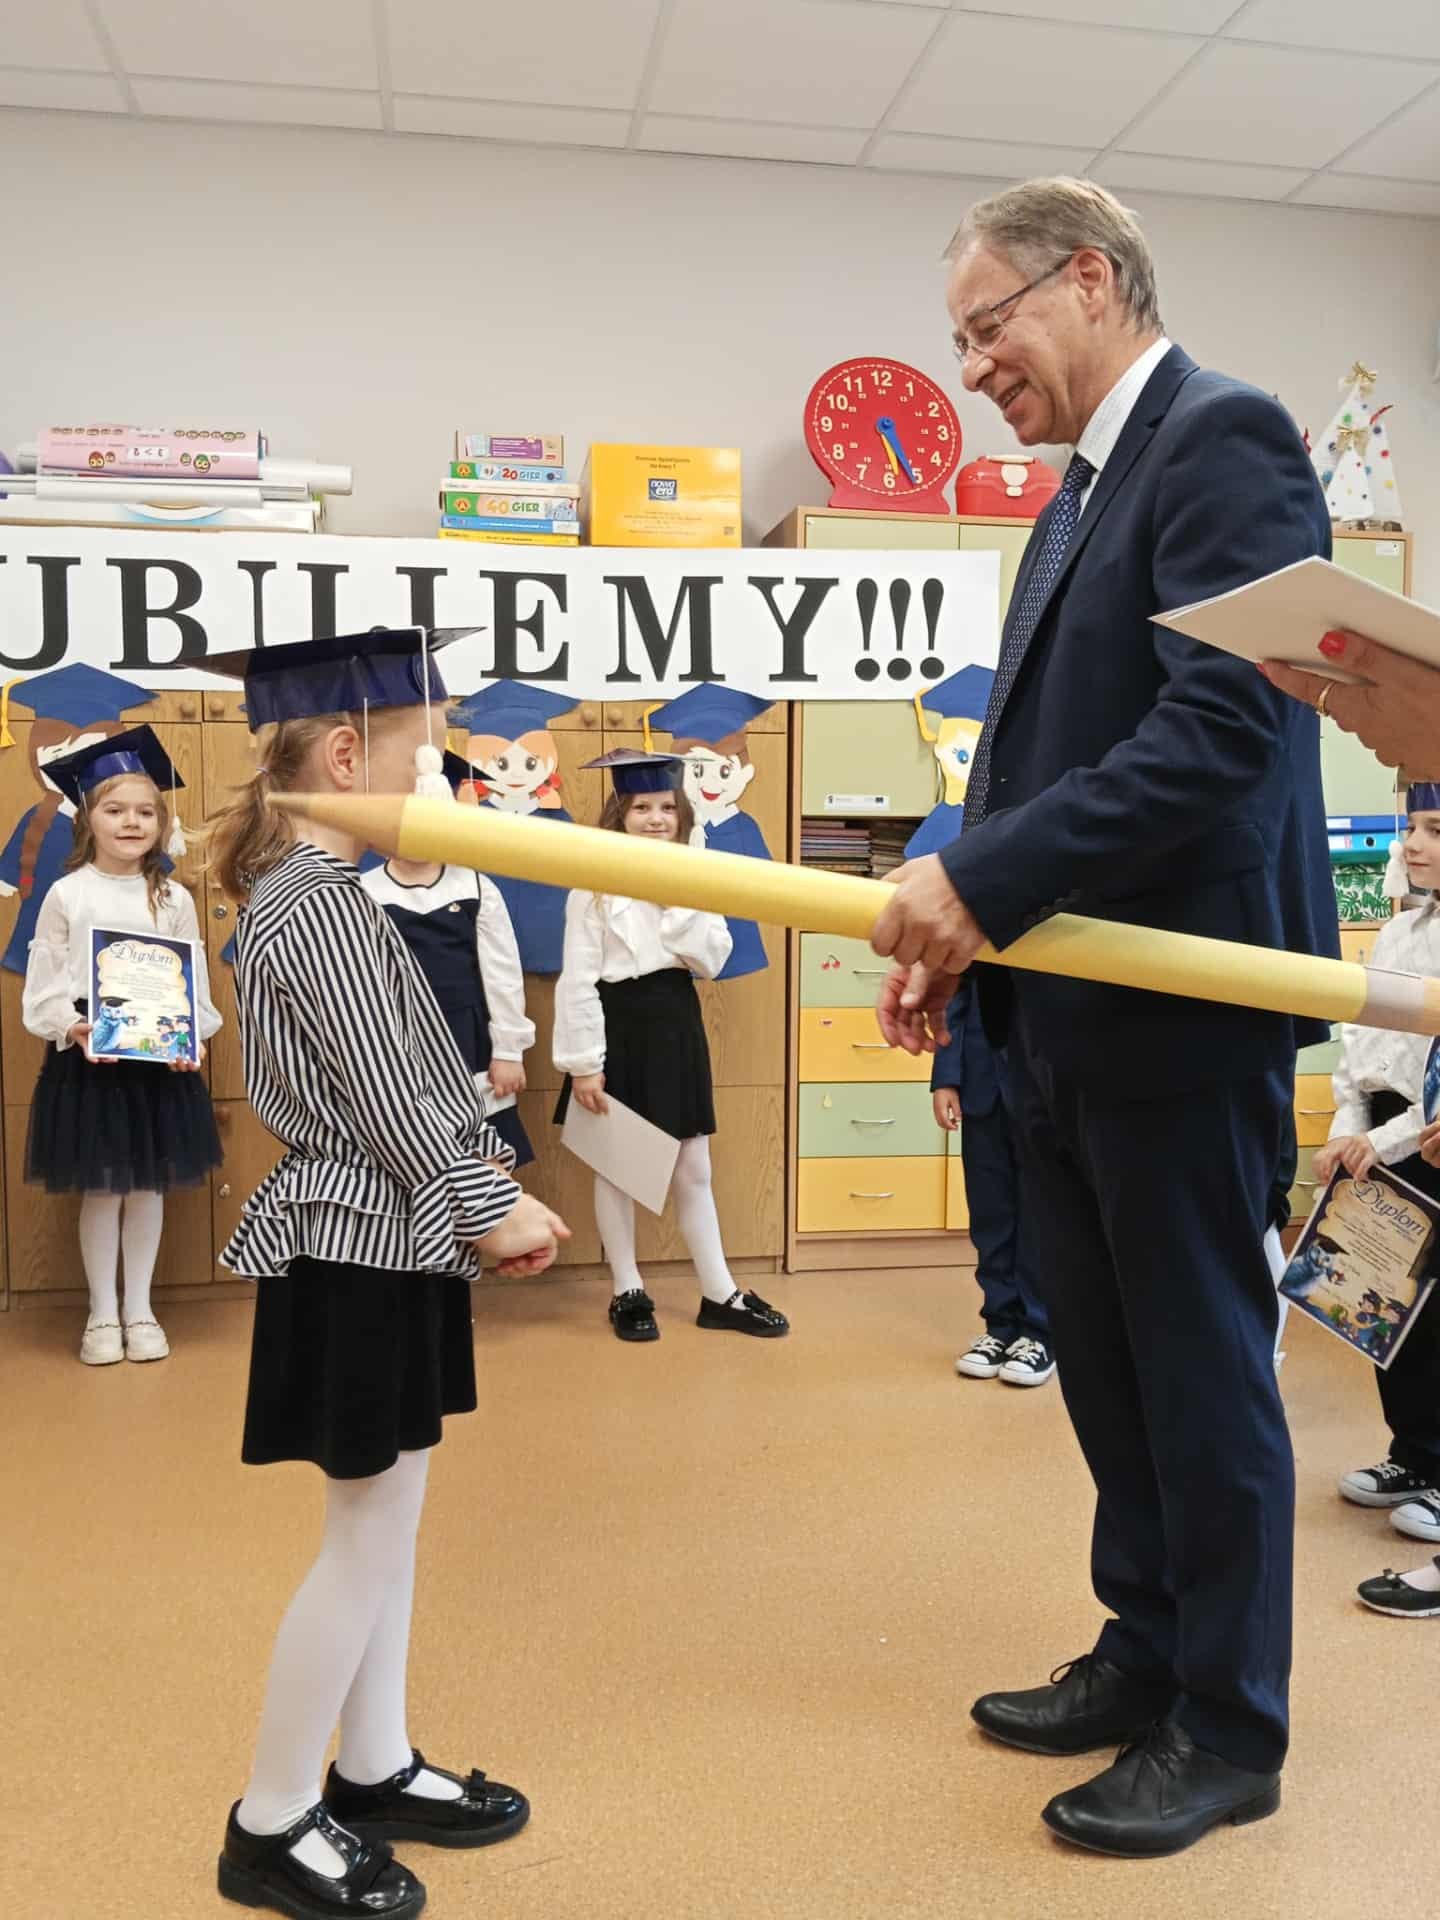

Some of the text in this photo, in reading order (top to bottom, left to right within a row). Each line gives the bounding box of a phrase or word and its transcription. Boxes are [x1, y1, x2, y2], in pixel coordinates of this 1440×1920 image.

[843, 376, 863, 393] 11
[871, 370, 893, 387] 12
[905, 381, 914, 397] 1
[826, 395, 848, 410] 10
[928, 402, 940, 418] 2
[820, 416, 833, 433] 9
[936, 425, 949, 441] 3
[832, 444, 845, 460] 8
[930, 451, 942, 467] 4
[502, 467, 540, 480] 20 GIER
[855, 464, 868, 480] 7
[912, 467, 923, 484] 5
[650, 480, 676, 488] nowa
[883, 472, 896, 489] 6
[655, 487, 674, 496] era
[486, 499, 540, 514] 40 GIER
[109, 943, 174, 966] Dyplom
[1347, 1177, 1428, 1237] Dyplom
